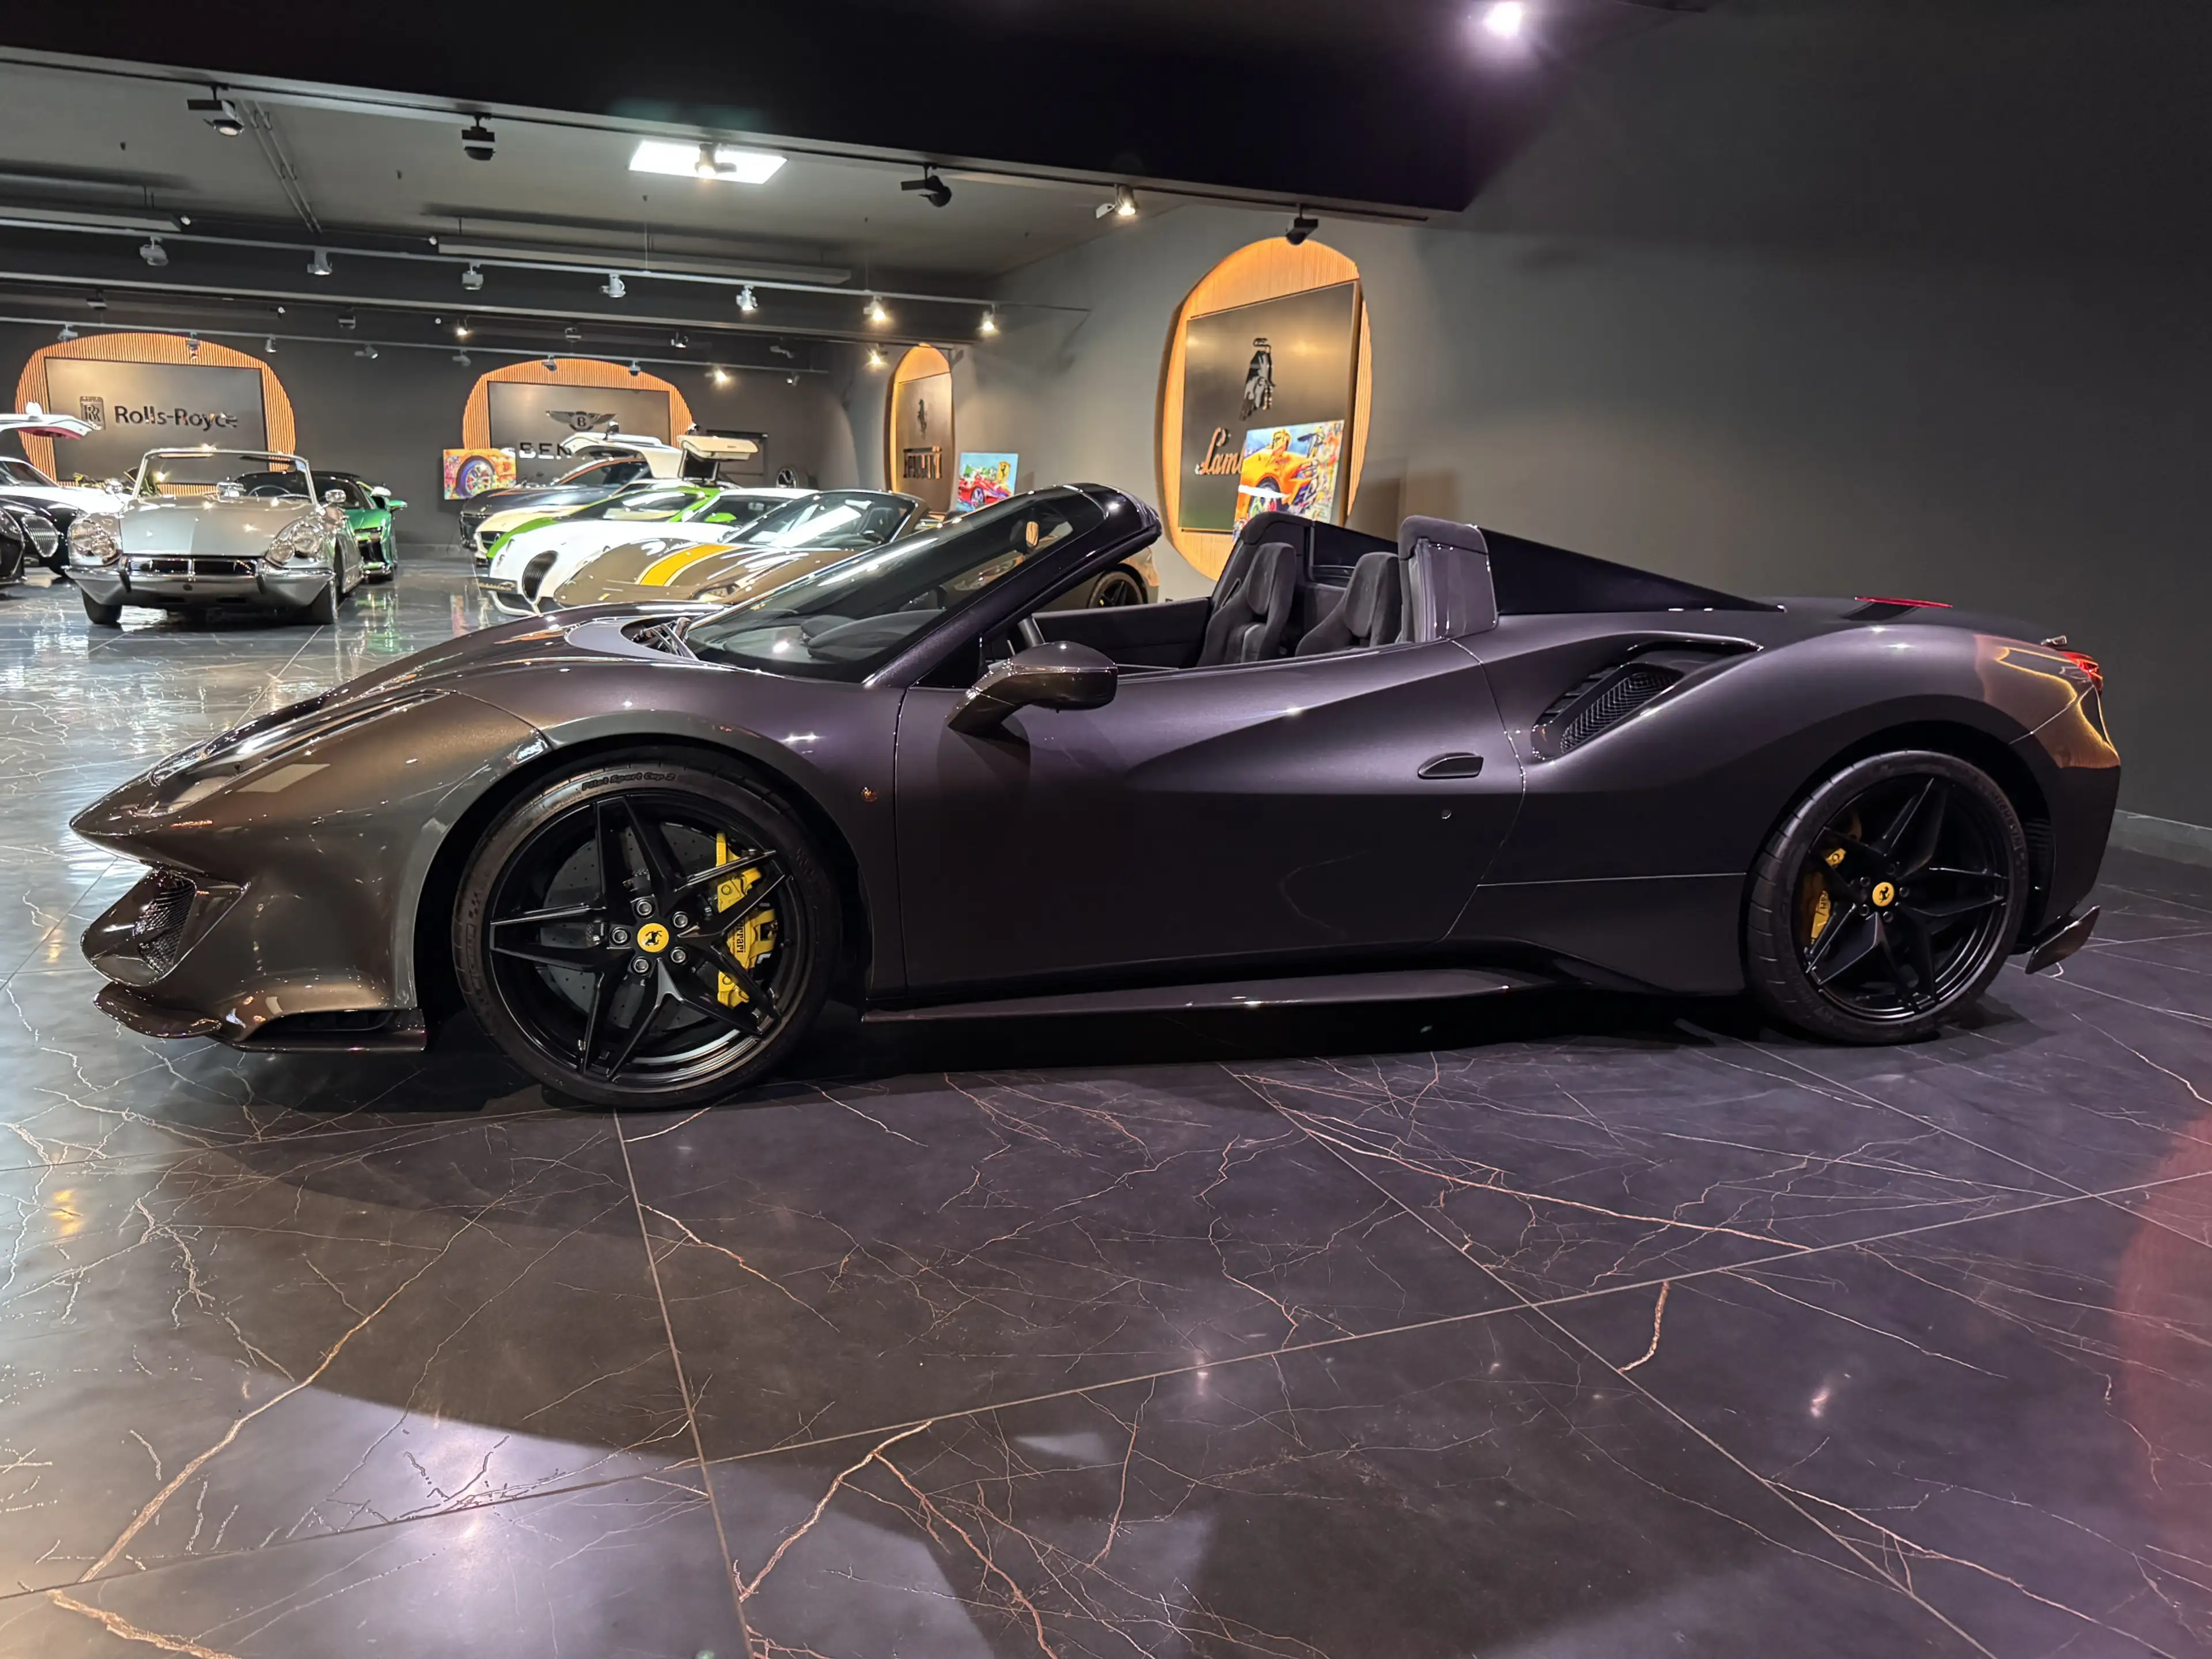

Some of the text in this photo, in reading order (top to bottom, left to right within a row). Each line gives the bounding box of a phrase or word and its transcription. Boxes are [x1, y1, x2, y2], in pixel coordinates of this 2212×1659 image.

[114, 406, 238, 432] Rolls-Royce
[519, 442, 572, 459] BEN
[1195, 427, 1245, 475] Lam
[582, 772, 676, 791] Pilot Sport Cup 2
